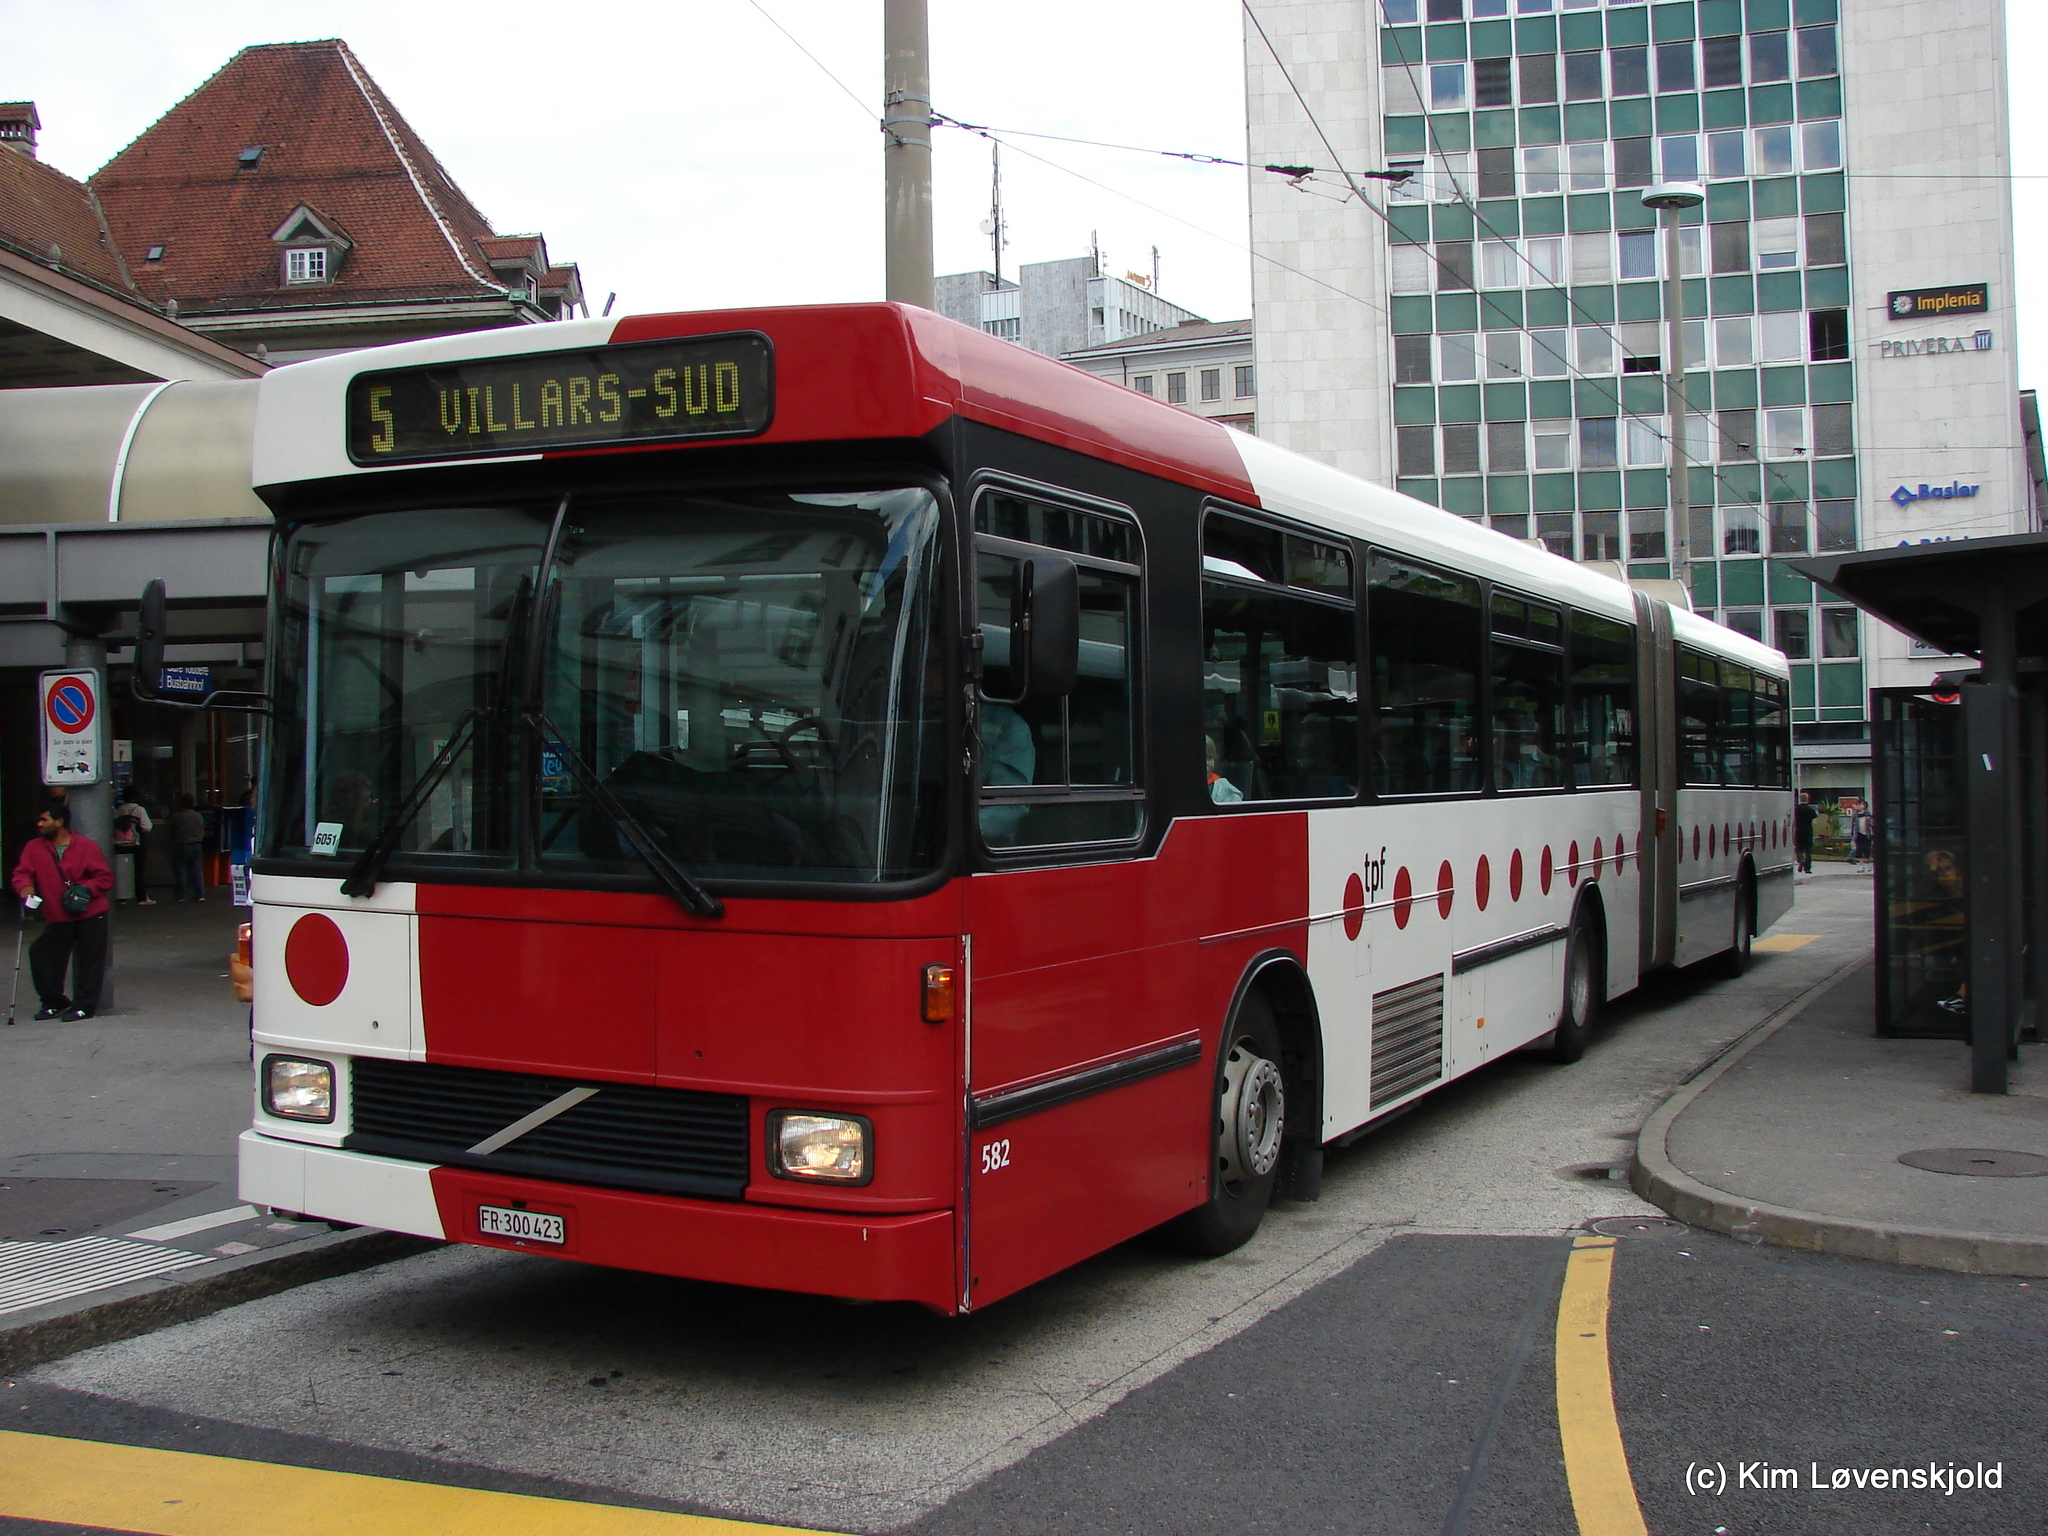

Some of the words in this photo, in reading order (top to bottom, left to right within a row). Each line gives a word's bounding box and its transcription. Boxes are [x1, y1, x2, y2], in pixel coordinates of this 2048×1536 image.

[1916, 290, 1981, 312] Implenia
[1881, 336, 1965, 358] PRIVERA
[369, 386, 396, 453] 5
[439, 361, 740, 436] VILLARS-SUD
[1918, 480, 1980, 499] Basler
[166, 675, 204, 691] Busbahnhof
[315, 832, 338, 846] 6051
[1364, 846, 1386, 903] tpf
[981, 1138, 1010, 1175] 582
